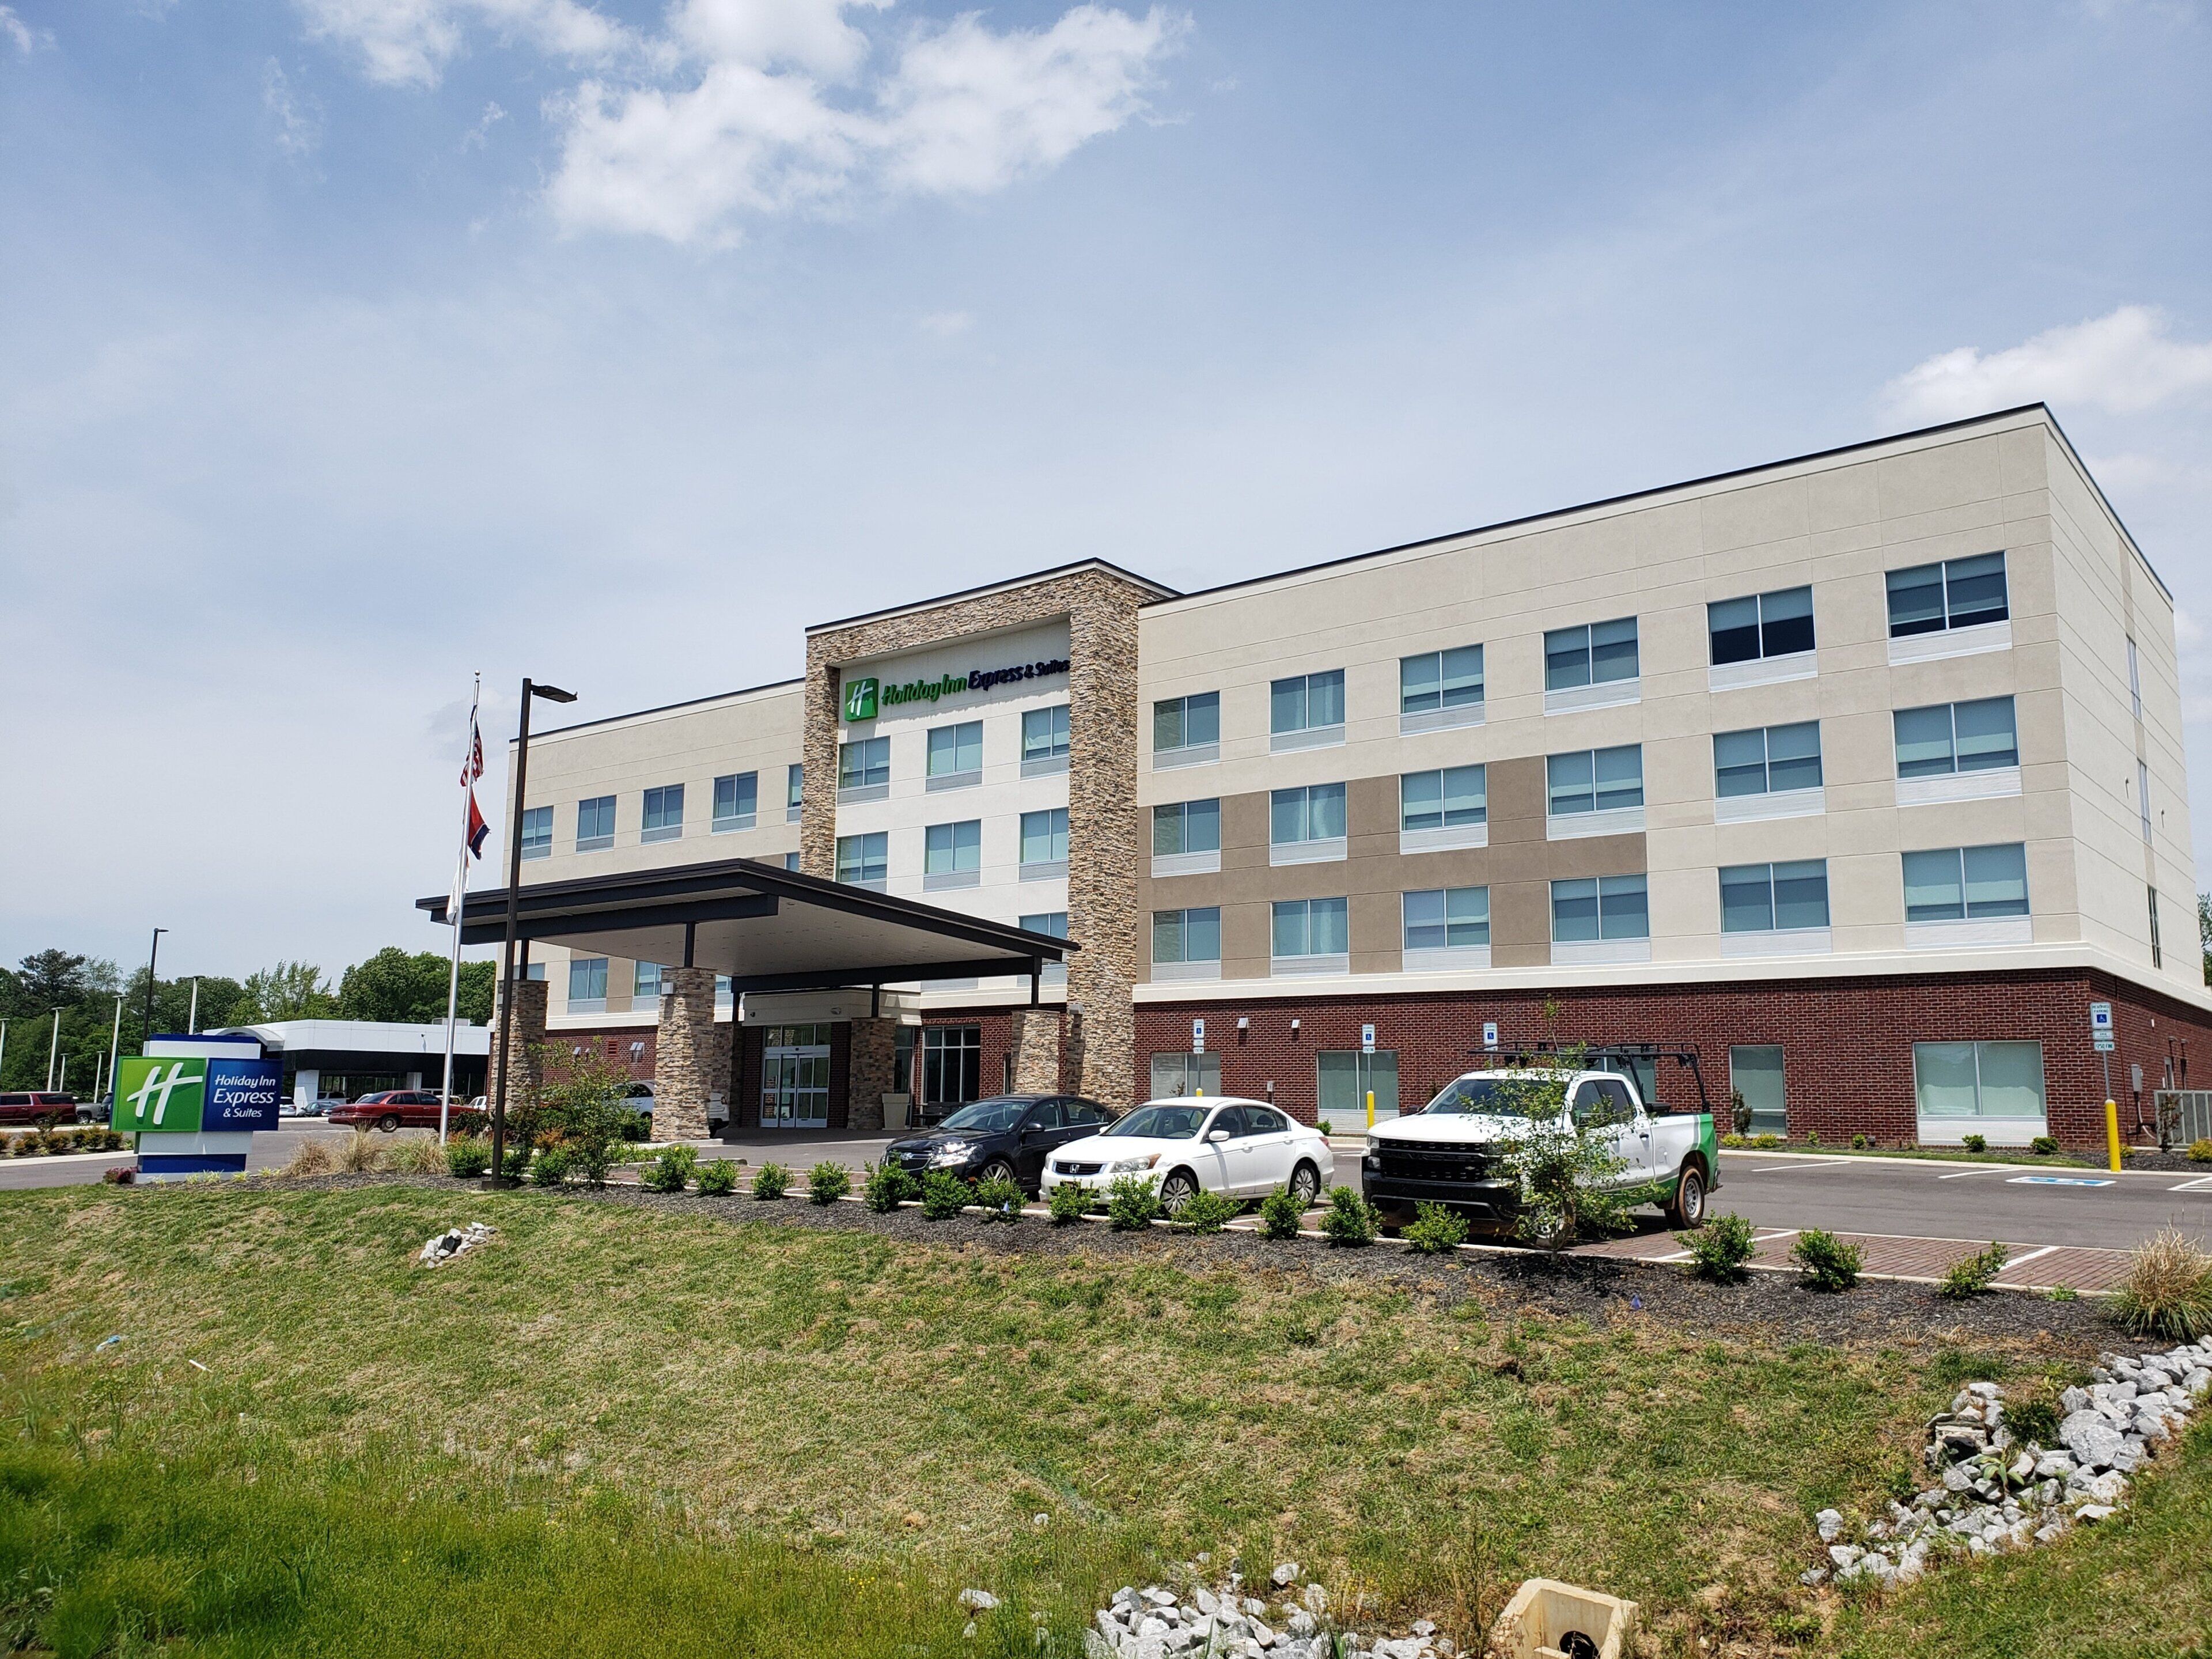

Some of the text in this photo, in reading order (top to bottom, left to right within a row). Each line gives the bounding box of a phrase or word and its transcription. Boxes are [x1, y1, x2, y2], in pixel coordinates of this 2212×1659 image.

[881, 659, 1070, 706] Holiday Inn Express & Suites
[215, 1074, 276, 1088] Holiday Inn
[213, 1088, 275, 1107] Express
[223, 1108, 263, 1118] & Suites
